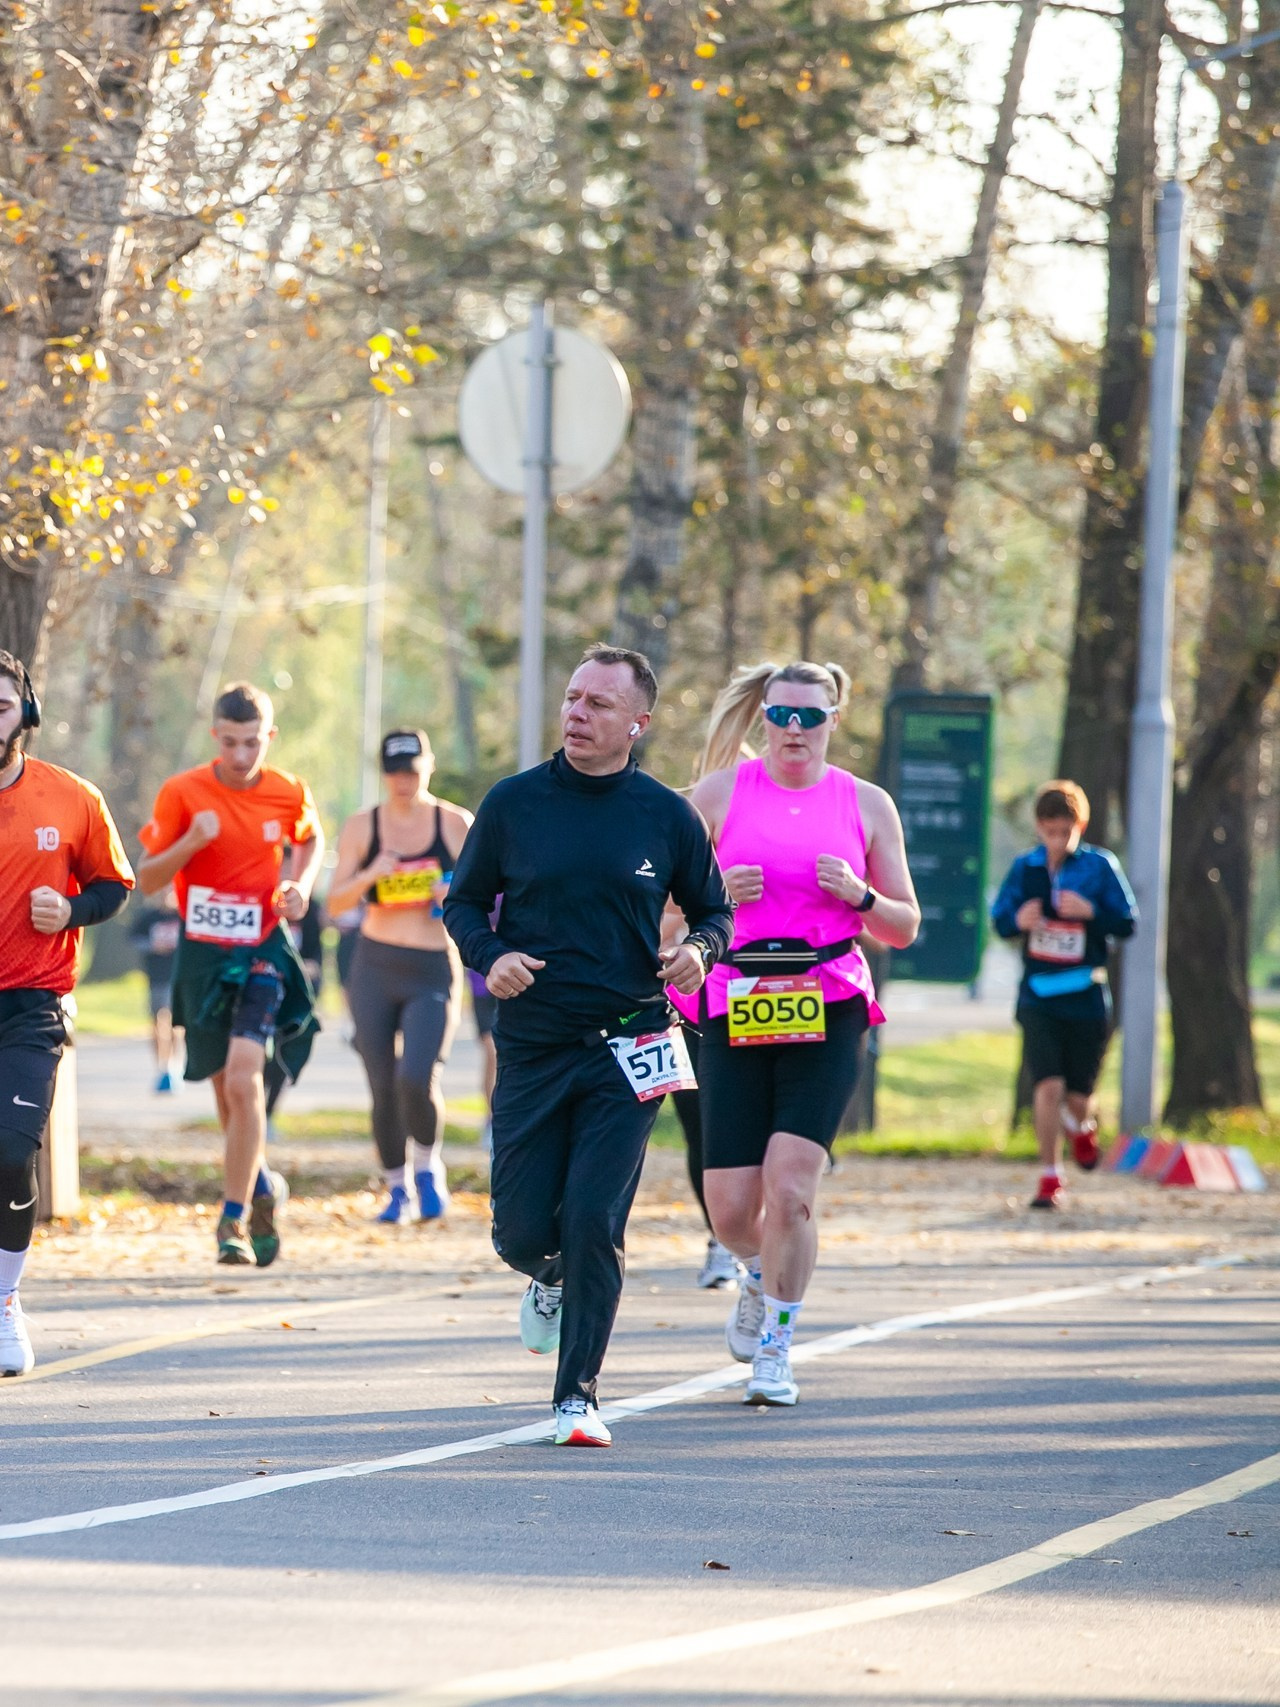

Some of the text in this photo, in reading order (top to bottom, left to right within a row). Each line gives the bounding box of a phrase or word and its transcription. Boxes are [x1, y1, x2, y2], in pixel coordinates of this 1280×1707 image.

[34, 826, 60, 851] 10
[192, 904, 255, 928] 5834
[733, 996, 819, 1025] 5050
